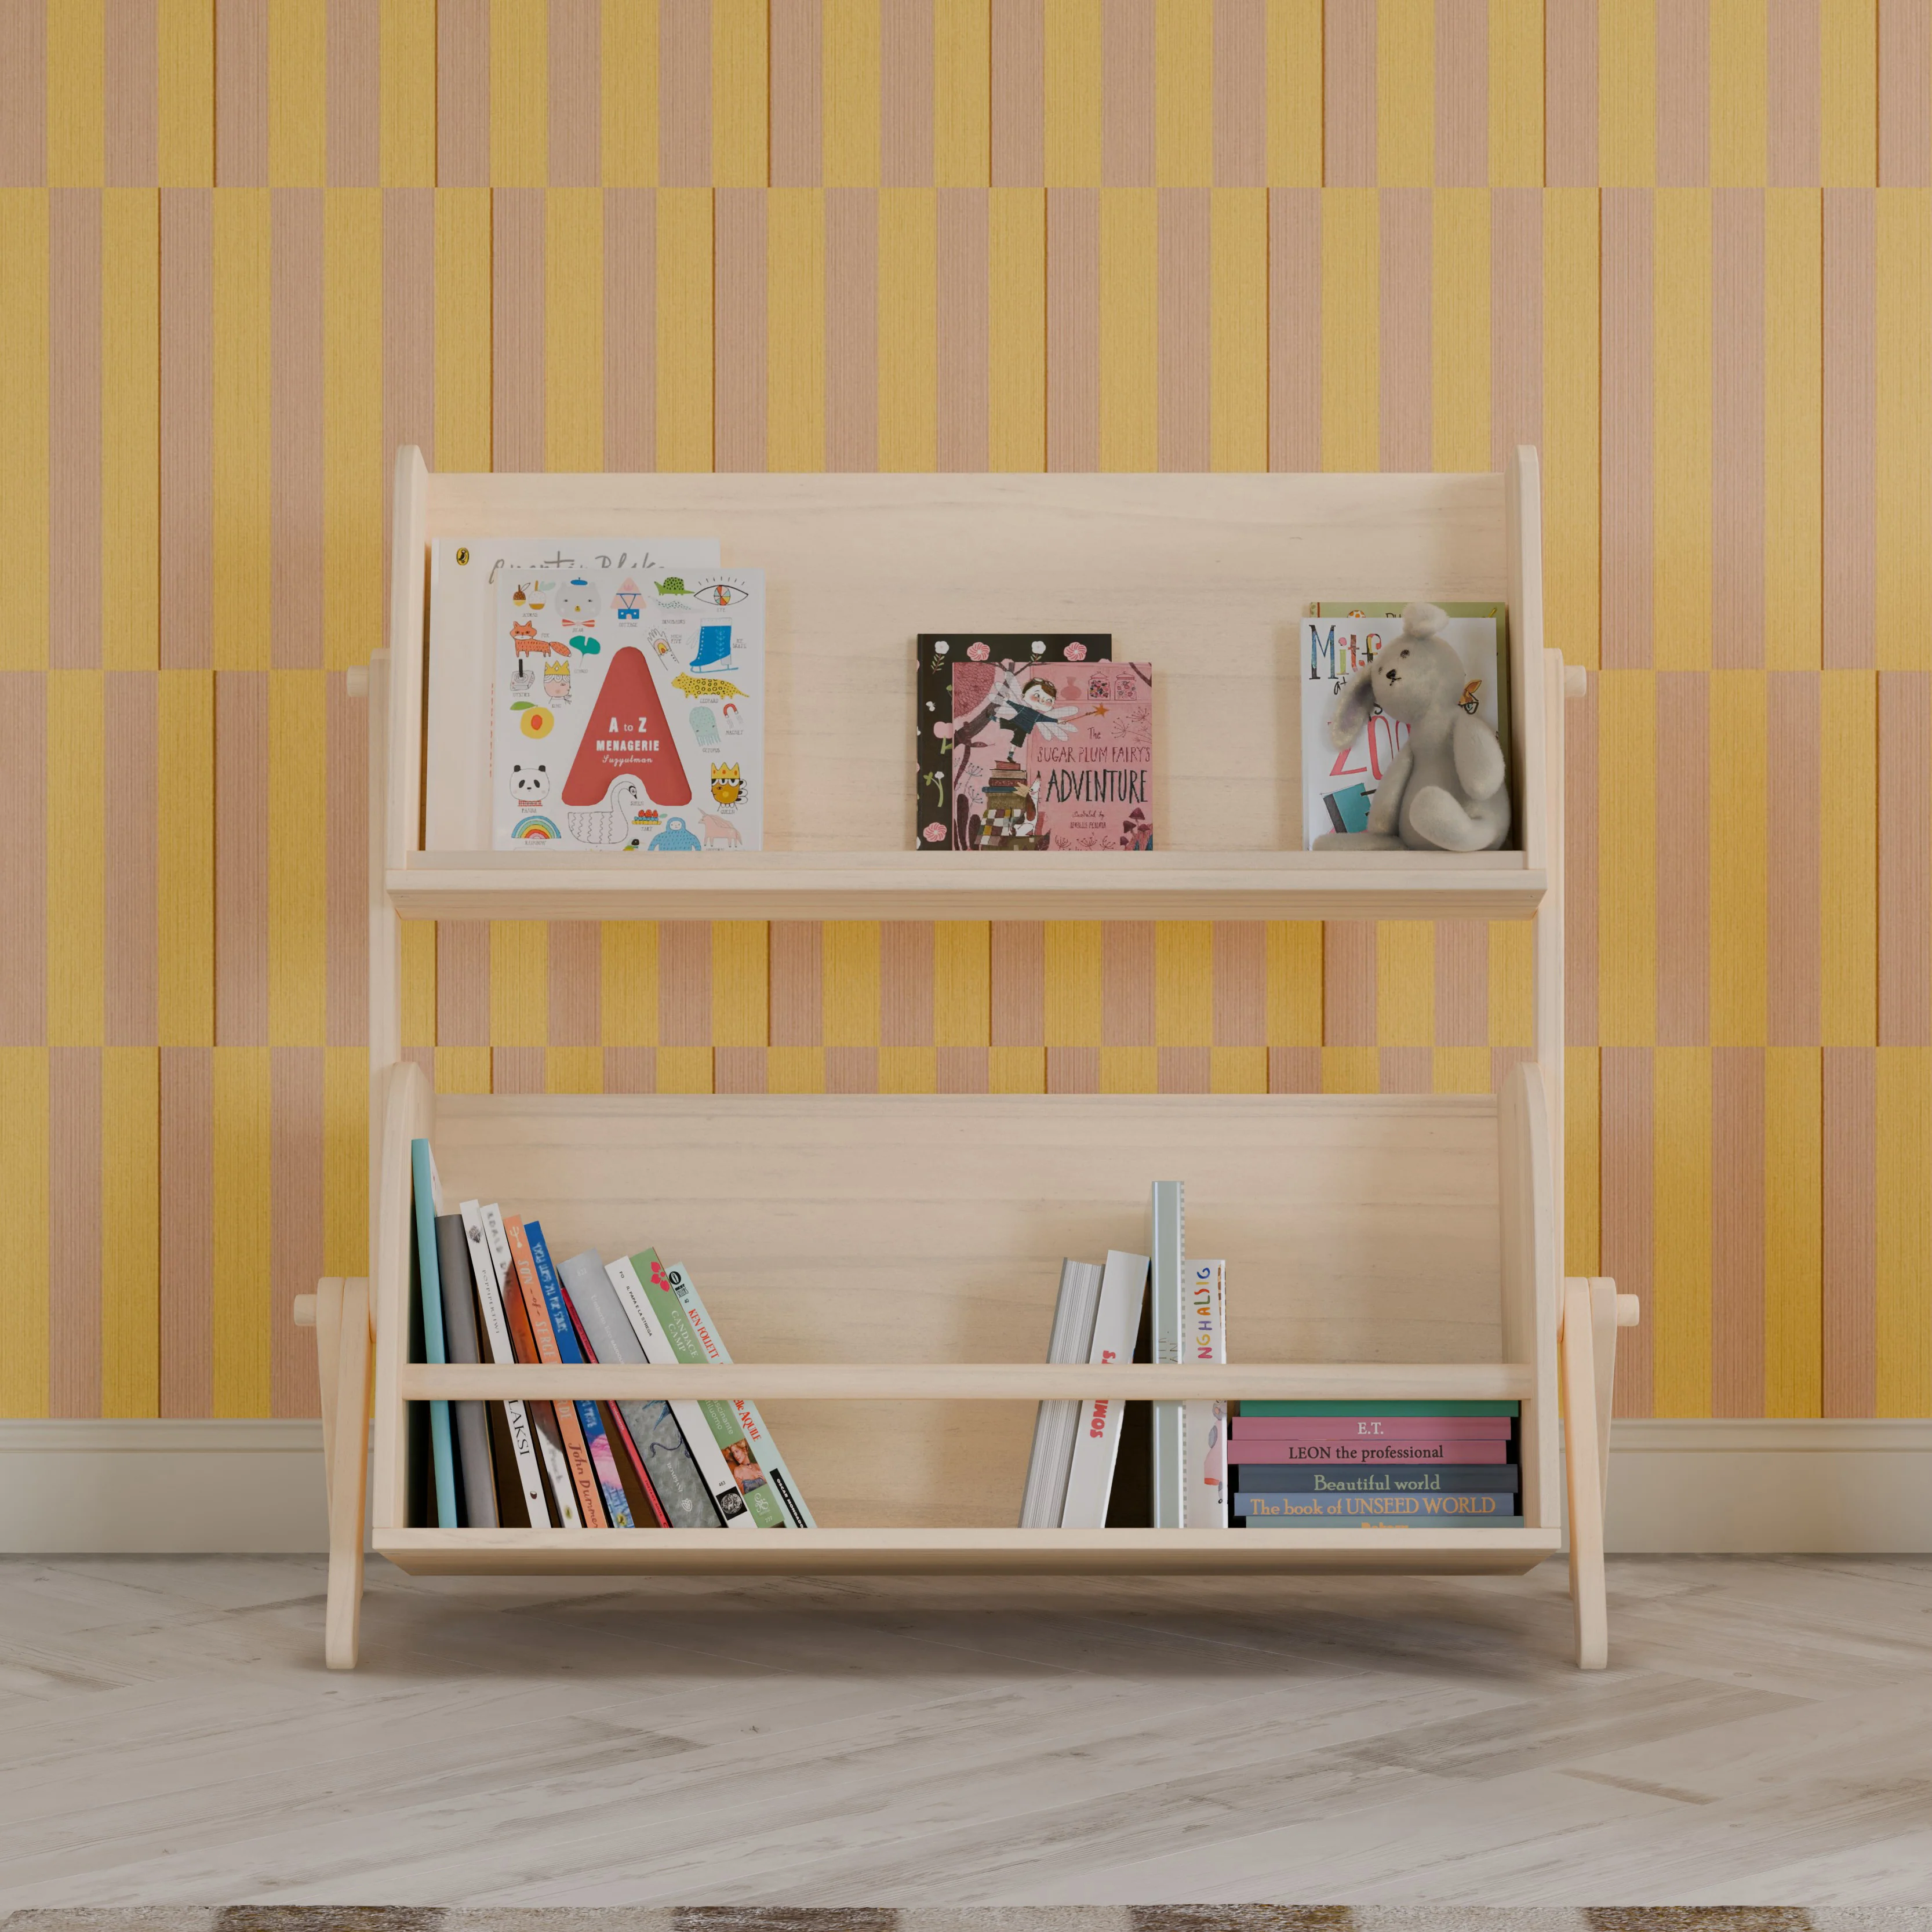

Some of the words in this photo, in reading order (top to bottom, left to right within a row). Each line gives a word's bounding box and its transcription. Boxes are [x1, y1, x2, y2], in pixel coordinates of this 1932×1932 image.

[609, 716, 618, 733] A
[624, 723, 634, 732] to
[638, 716, 647, 733] Z
[1088, 727, 1101, 739] The
[596, 740, 659, 751] MENAGERIE
[1037, 746, 1076, 762] SUGAR
[1079, 746, 1108, 763] PLUM
[1112, 746, 1150, 762] FAIRY'S
[1046, 769, 1147, 803] ADVENTURE
[676, 1287, 689, 1298] SELLERS
[638, 1309, 642, 1317] LA
[641, 1317, 652, 1337] STREGA
[668, 1323, 686, 1352] CAMP
[671, 1310, 698, 1358] CANDACE
[688, 1308, 703, 1327] KEN
[697, 1326, 719, 1358] FOLLETT
[739, 1411, 762, 1442] AQUILE
[1358, 1422, 1384, 1435] E.T.
[569, 1443, 587, 1475] John
[1289, 1447, 1331, 1459] LEON
[1336, 1446, 1357, 1458] the
[1361, 1445, 1444, 1462] professional
[667, 1462, 683, 1493] BOMPIANI
[1314, 1475, 1391, 1490] Beautiful
[1394, 1474, 1440, 1490] world
[777, 1479, 789, 1498] OSCAR
[645, 1480, 656, 1502] INSTANT
[654, 1502, 663, 1517] BOOK
[1250, 1498, 1280, 1515] The
[1283, 1498, 1323, 1515] book
[1327, 1498, 1342, 1514] of
[1346, 1497, 1419, 1514] UNSEED
[1422, 1497, 1496, 1513] WORLD
